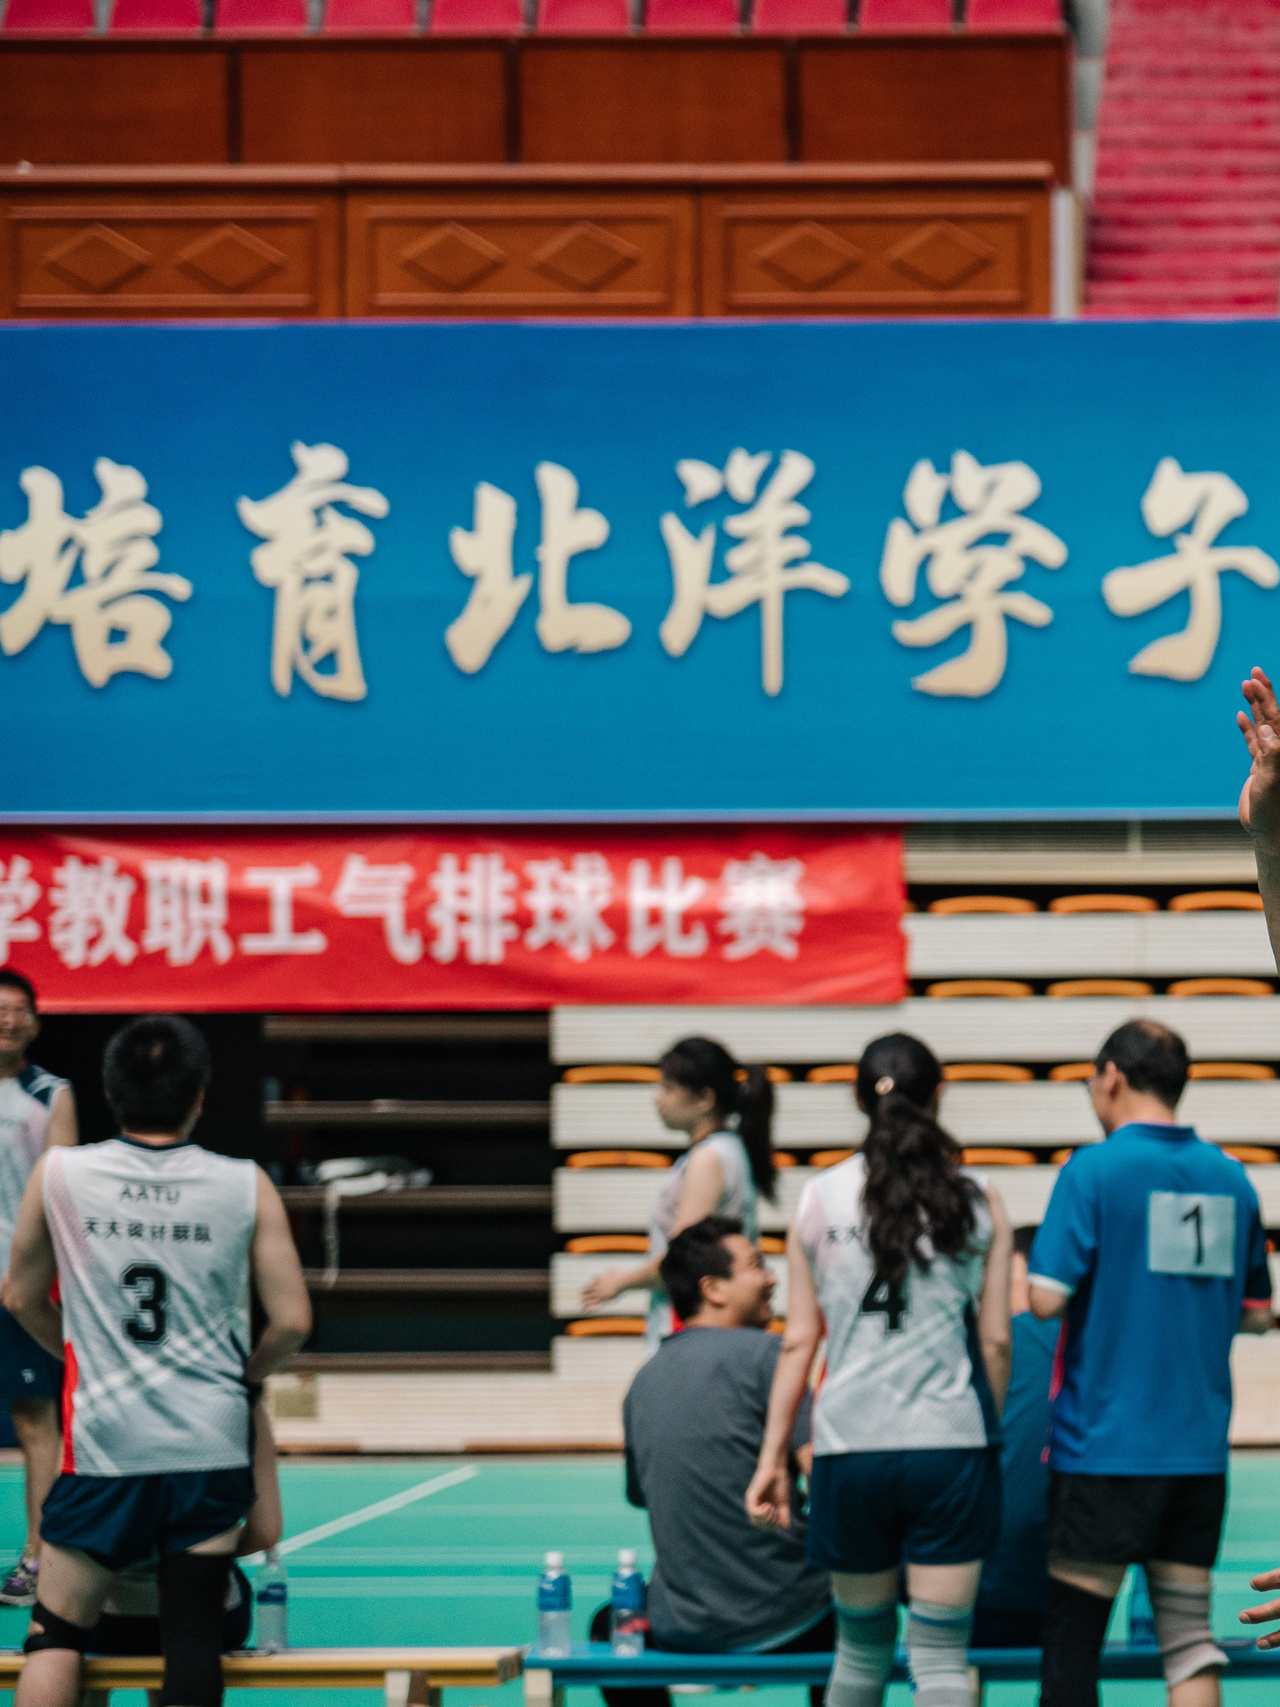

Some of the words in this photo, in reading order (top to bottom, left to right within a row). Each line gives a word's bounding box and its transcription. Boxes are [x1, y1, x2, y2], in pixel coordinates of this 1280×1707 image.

[1182, 1204, 1204, 1265] 1
[121, 1261, 170, 1345] 3
[859, 1258, 909, 1336] 4
